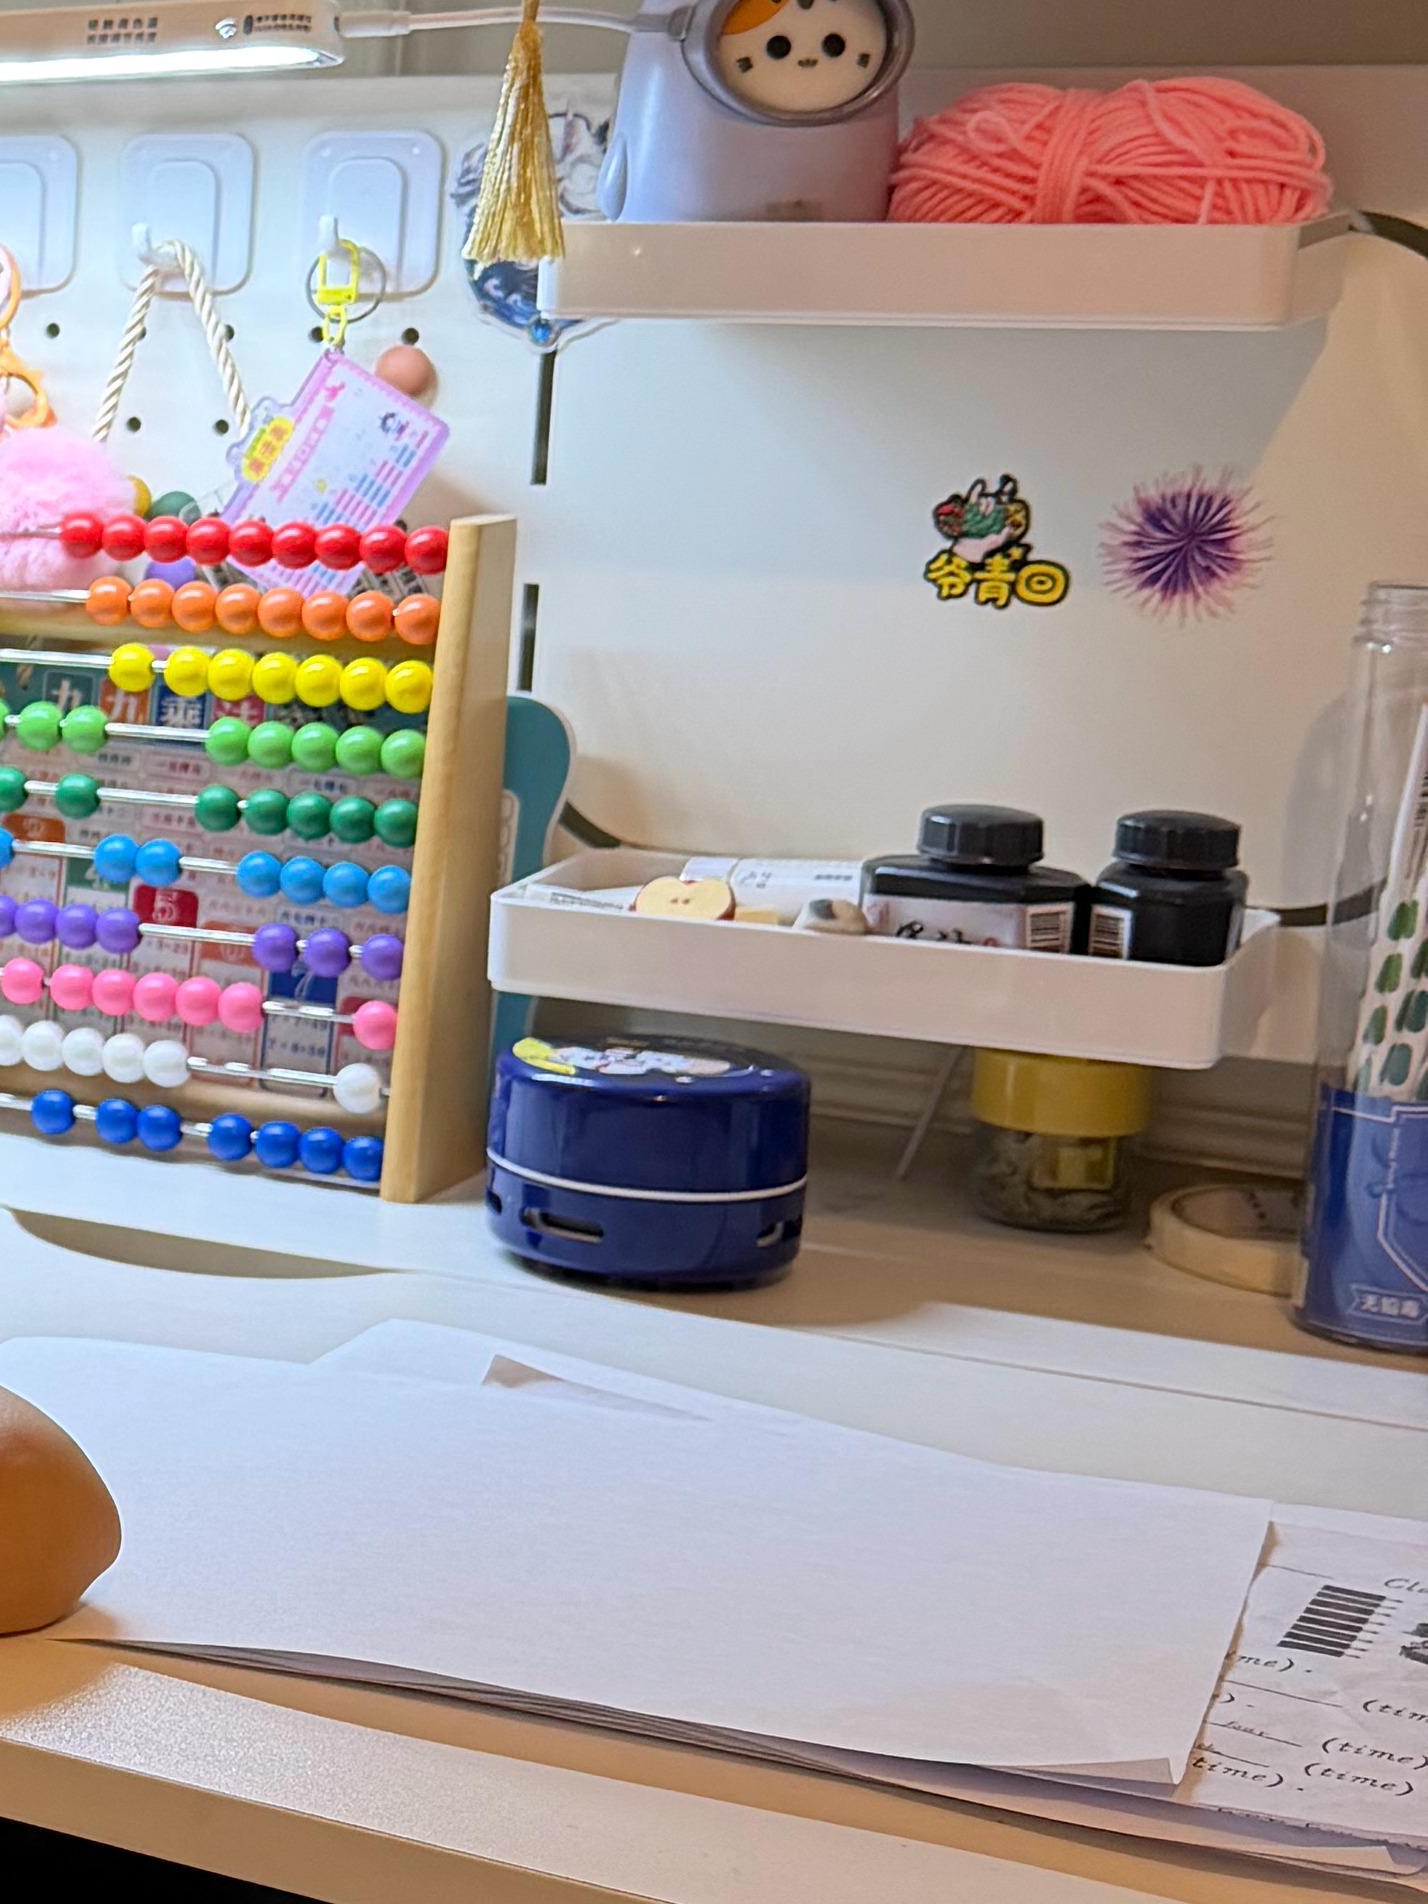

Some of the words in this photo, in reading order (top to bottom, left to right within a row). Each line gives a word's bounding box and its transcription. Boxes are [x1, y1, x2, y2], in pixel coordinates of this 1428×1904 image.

[925, 553, 1069, 609] 爷青回
[1304, 1762, 1414, 1797] (time)
